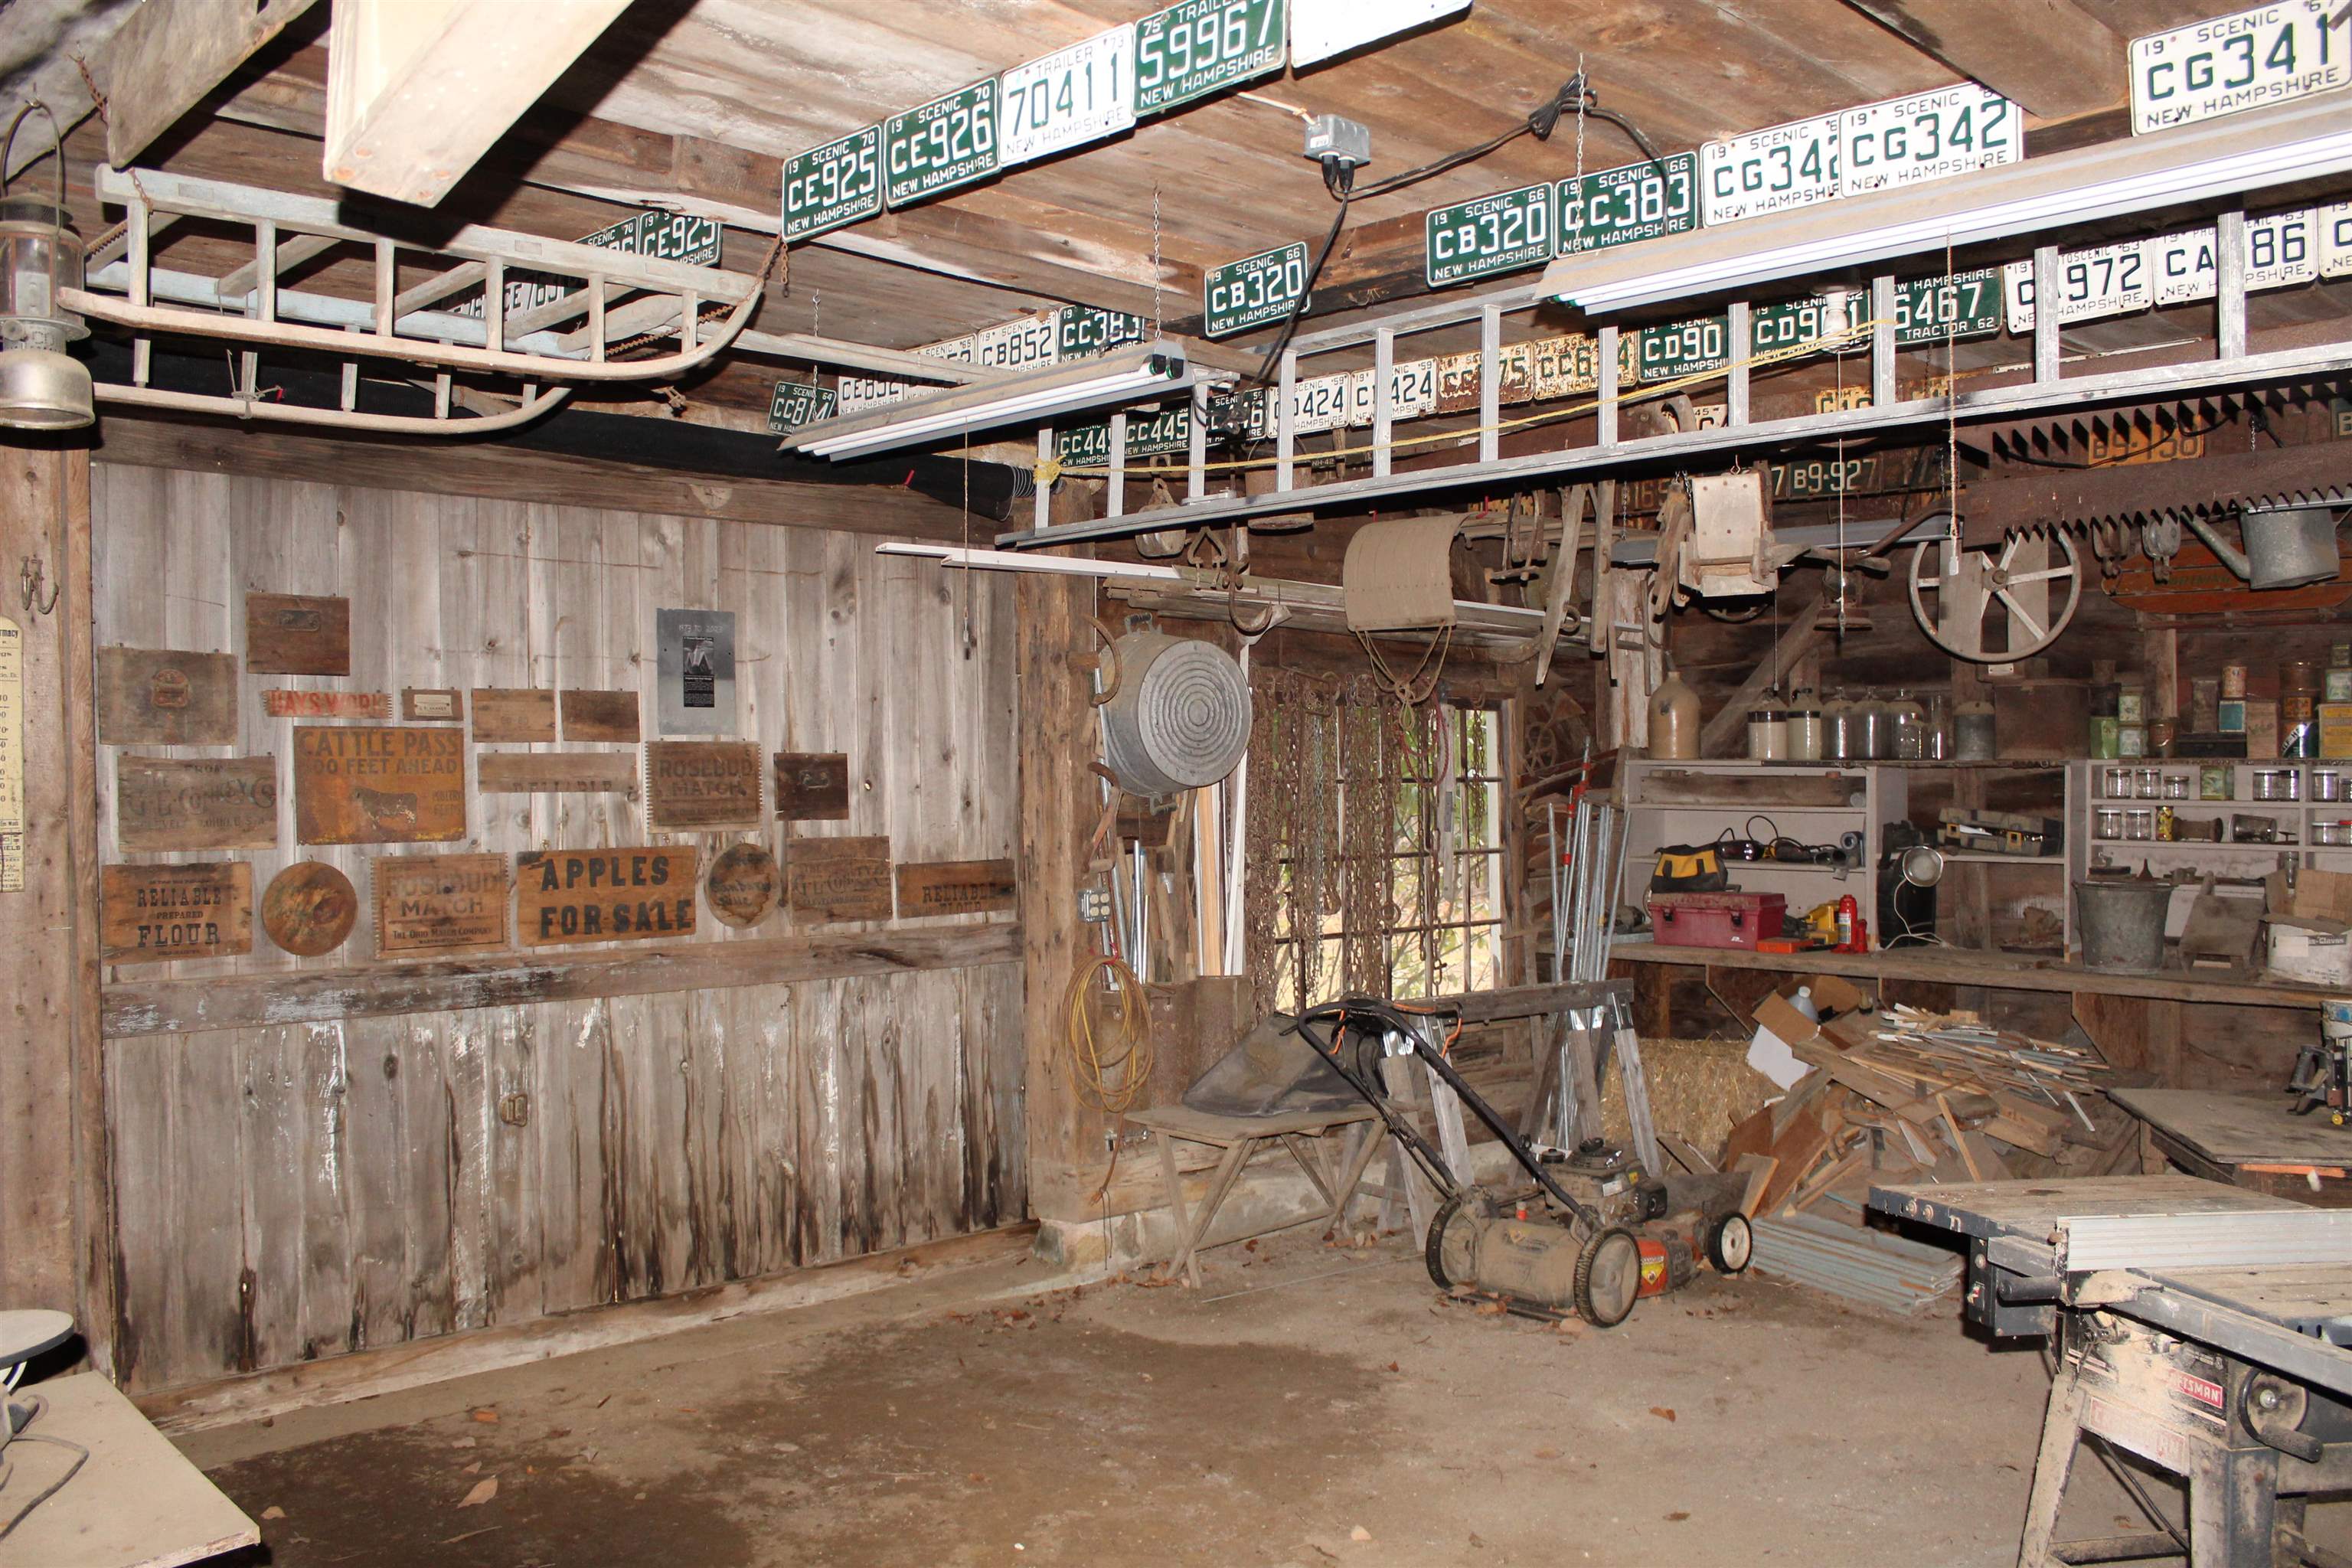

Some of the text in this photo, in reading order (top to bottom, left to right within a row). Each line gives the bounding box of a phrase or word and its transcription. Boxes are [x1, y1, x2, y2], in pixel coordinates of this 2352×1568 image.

[1143, 0, 1235, 35] 75 TRAIL
[2145, 9, 2279, 57] 19 SCENIC
[1036, 36, 1125, 75] TRAILER 73
[1140, 0, 1274, 89] 59967
[2147, 13, 2328, 101] CG341
[1141, 45, 1275, 107] NEW HAMPSHIRE
[891, 85, 990, 134] 19 SCENIC 70
[1008, 52, 1119, 136] 70411
[1851, 92, 1960, 127] 19 SCENIC
[2147, 67, 2339, 129] NEW HAMPSHIRE
[891, 101, 992, 175] CE926
[1007, 106, 1124, 155] NEW HAMPSHIRE
[1712, 126, 1808, 159] 19 SCENIC
[1852, 98, 2007, 168] CG342
[789, 132, 875, 175] 19 SCENIC 70
[789, 145, 876, 212] CE925
[892, 152, 994, 198] NEW HAMPSHIRE
[1564, 158, 1688, 196] 19 SCENIC 66
[1851, 150, 2007, 191] NEW HAMPSHIRE
[787, 194, 874, 234] NEW HAMPSHIRE
[1434, 189, 1545, 225] 19 SCENIC 66
[1564, 172, 1690, 231] CC383
[1713, 183, 1839, 220] NEW HAMPSHI
[588, 230, 616, 246] SCENIC
[624, 224, 634, 236] 70
[645, 216, 653, 228] 19
[1436, 202, 1547, 260] CB320
[1563, 217, 1687, 252] NEW HAMPSHRE
[1236, 256, 1275, 275] SCENIC
[1286, 247, 1300, 260] 66
[1435, 244, 1545, 279] NEW HAMPSHIRE
[2014, 263, 2027, 274] 19
[2122, 243, 2140, 253] 63
[2167, 222, 2305, 276] CA86
[2333, 256, 2352, 268] NE
[1212, 260, 1303, 313] CB320
[1914, 269, 1994, 290] HAMPSHIRE
[2017, 253, 2141, 306] C972
[2166, 264, 2305, 297] NEW HPSHIRE
[1063, 309, 1072, 320] 19
[1211, 299, 1295, 332] NEW HAMPSHIR
[1756, 307, 1768, 316] 19
[1785, 297, 1826, 312] SCENI
[2018, 292, 2141, 325] NE HAMPSHIRE
[982, 321, 1031, 342] 19 SCENIC
[1757, 302, 1858, 345] CD91
[1905, 318, 1994, 340] TRACTOR 62
[926, 343, 954, 357] SCENIC
[962, 339, 972, 350] 65
[982, 326, 1053, 368] CB852
[1061, 351, 1081, 363] NEW
[1540, 338, 1629, 378] CC64
[1645, 324, 1721, 361] CD90
[1356, 374, 1364, 383] 19
[1421, 361, 1432, 371] 59
[1444, 357, 1526, 390] CC75
[1645, 357, 1729, 377] NEW HAMPSHI
[778, 385, 786, 394] 19
[822, 393, 832, 401] 64
[1294, 375, 1345, 393] SCENIC 59
[1357, 371, 1432, 407] C424
[1215, 395, 1238, 407] SCENI
[1392, 401, 1432, 416] MPSHIRE
[769, 423, 781, 431] NEW
[1125, 412, 1188, 443] CC445
[1294, 415, 1344, 430] HAMPSHIRE
[1060, 428, 1111, 455] CC44
[1142, 439, 1187, 453] HAMPSHIRE
[1076, 455, 1110, 465] HAMPSHI
[299, 730, 459, 757] CATTLE PASS
[347, 758, 458, 775] FEET AHEAD
[658, 759, 753, 778] ROSEBUD
[541, 856, 669, 891] APPLES
[137, 887, 221, 907] RELIABLE
[922, 882, 998, 903] RELIABLE
[156, 910, 204, 920] PREPARED
[540, 900, 692, 939] FOR SALE
[137, 923, 220, 948] FLOUR
